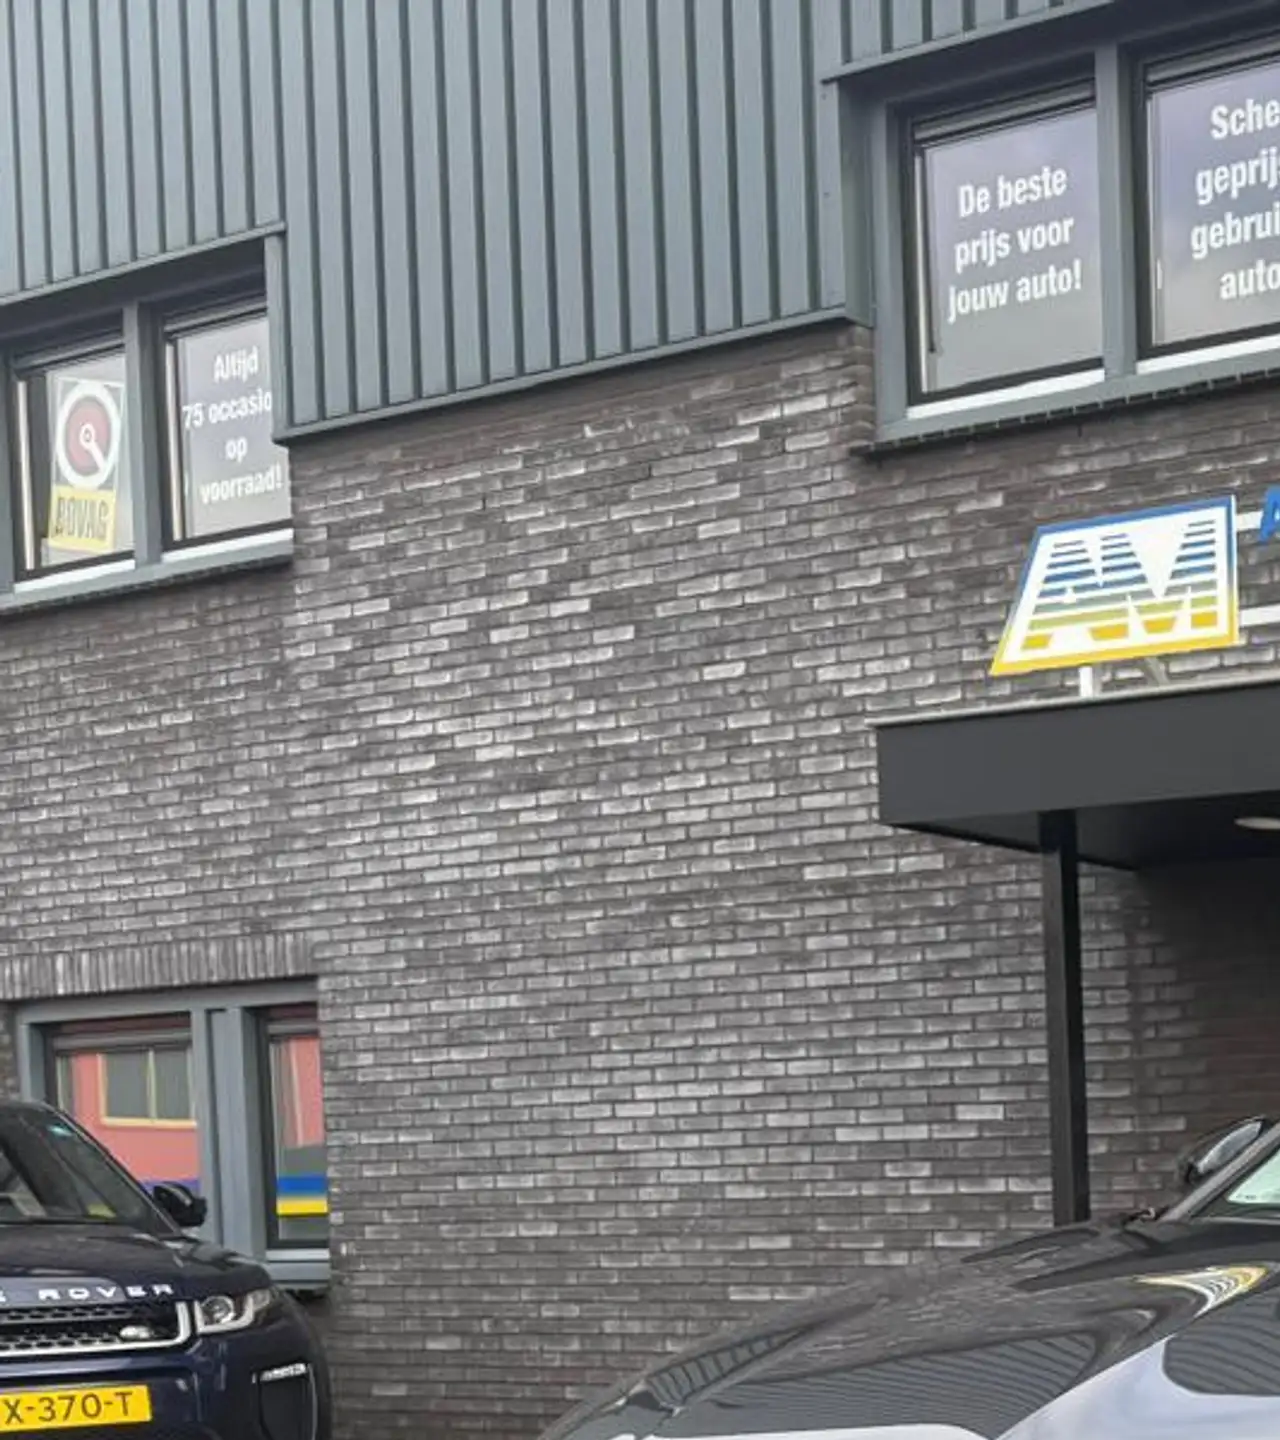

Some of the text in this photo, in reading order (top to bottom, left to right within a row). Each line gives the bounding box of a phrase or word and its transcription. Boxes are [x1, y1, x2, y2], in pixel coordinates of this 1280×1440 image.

[958, 165, 1068, 217] De beste
[954, 217, 1075, 274] prijs voor
[947, 258, 1083, 324] jouw auto!
[213, 346, 259, 382] Altijd
[182, 405, 204, 429] 75
[225, 436, 248, 463] op
[200, 465, 283, 503] voorraad!
[53, 495, 109, 541] BOVAG
[38, 1283, 174, 1301] ROVER
[4, 1391, 132, 1425] X-370-T
